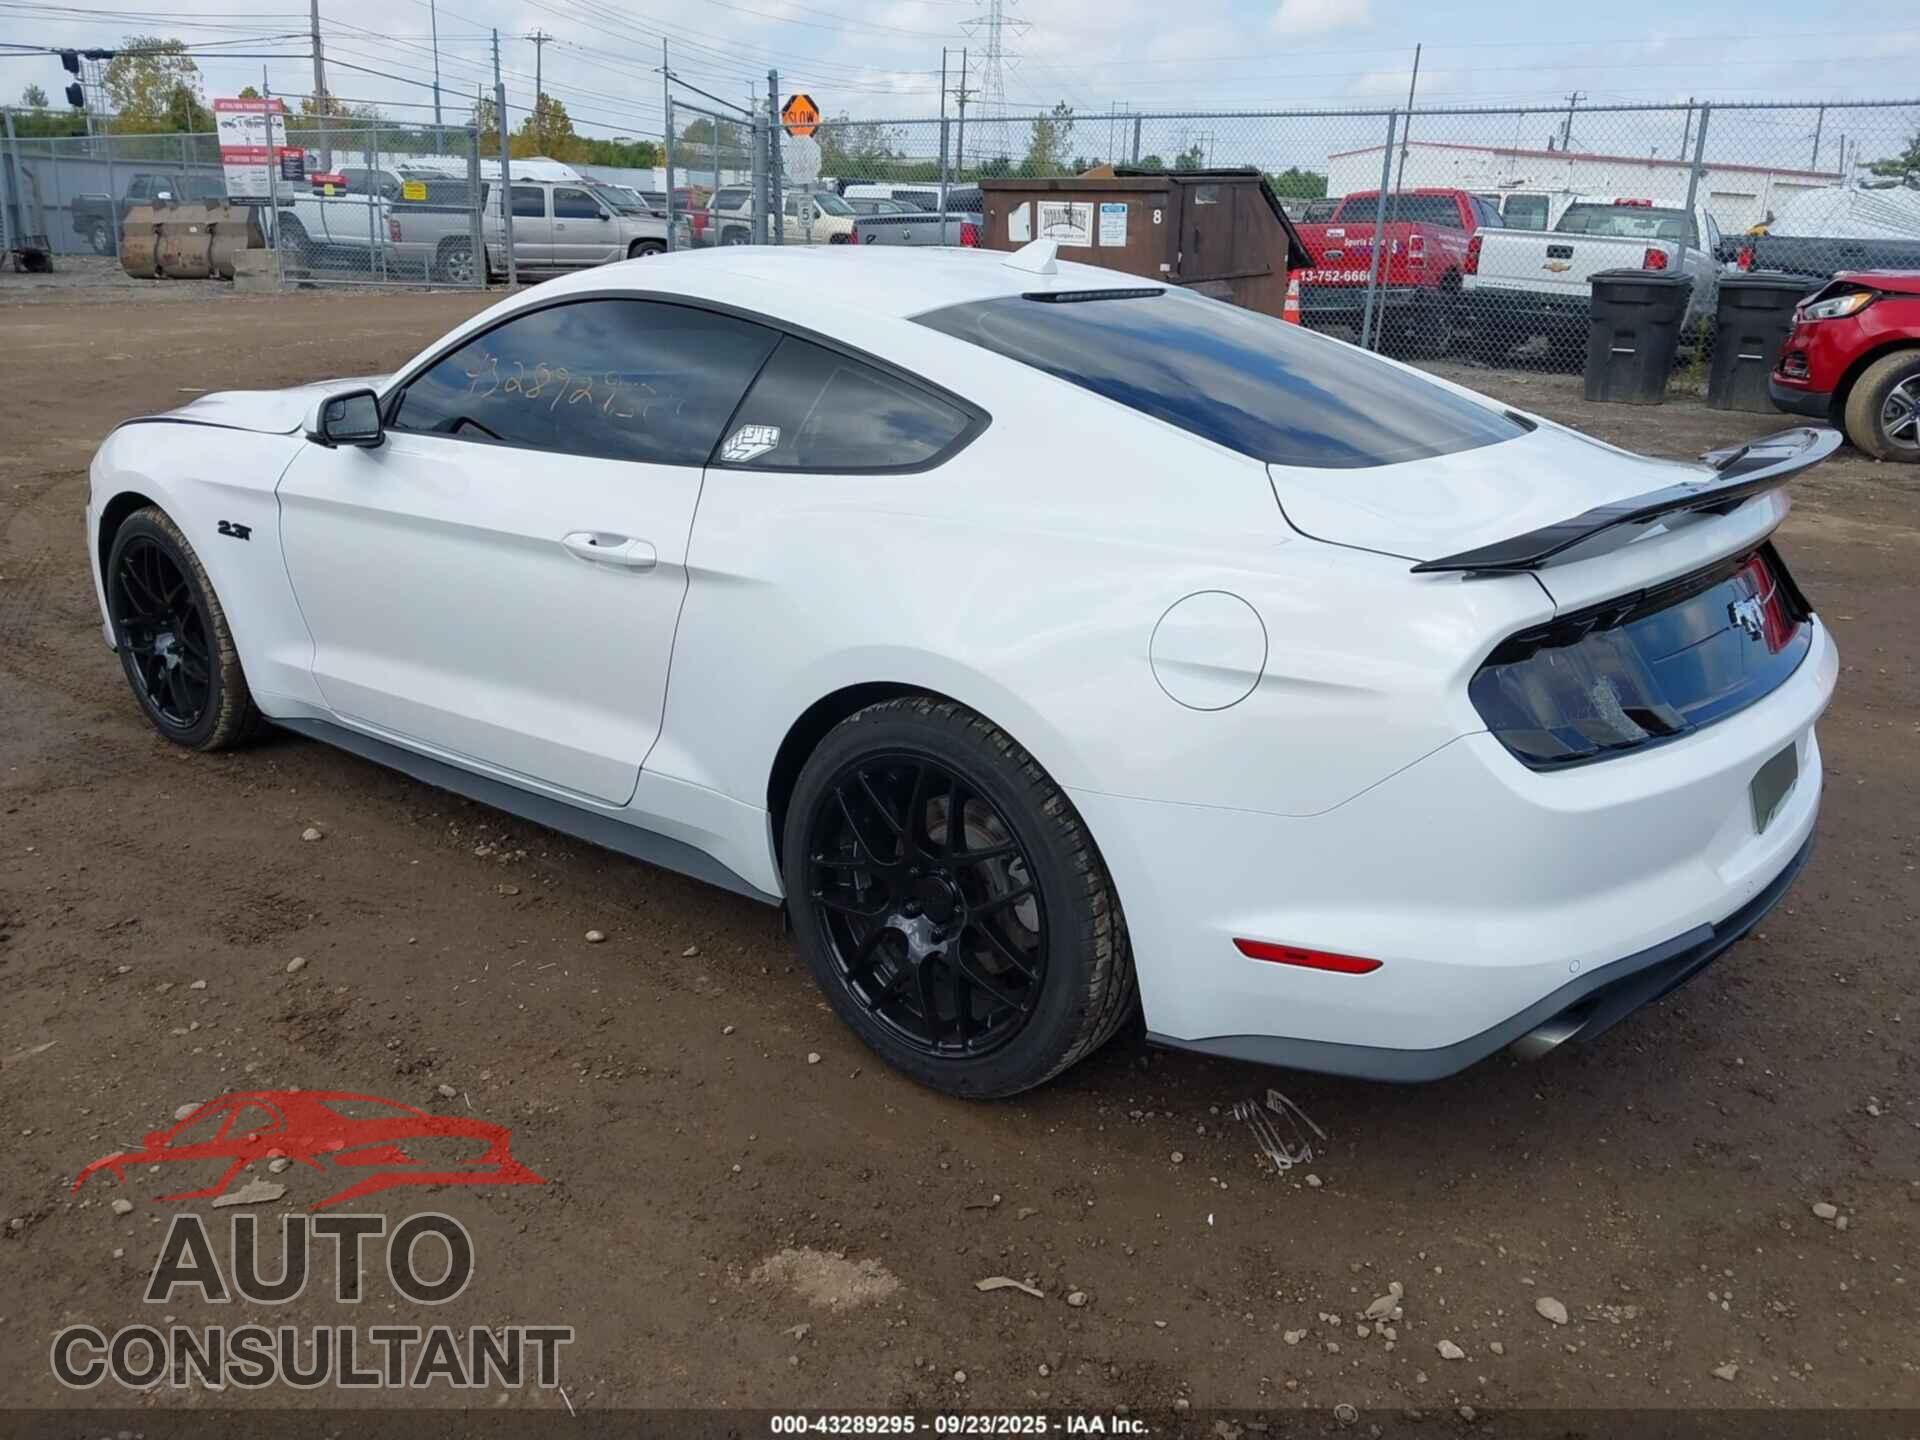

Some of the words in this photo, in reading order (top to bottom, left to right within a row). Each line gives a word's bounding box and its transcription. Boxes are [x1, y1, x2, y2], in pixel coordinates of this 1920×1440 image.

[788, 111, 814, 123] SLOW
[802, 208, 809, 221] 5
[1153, 209, 1162, 224] 8
